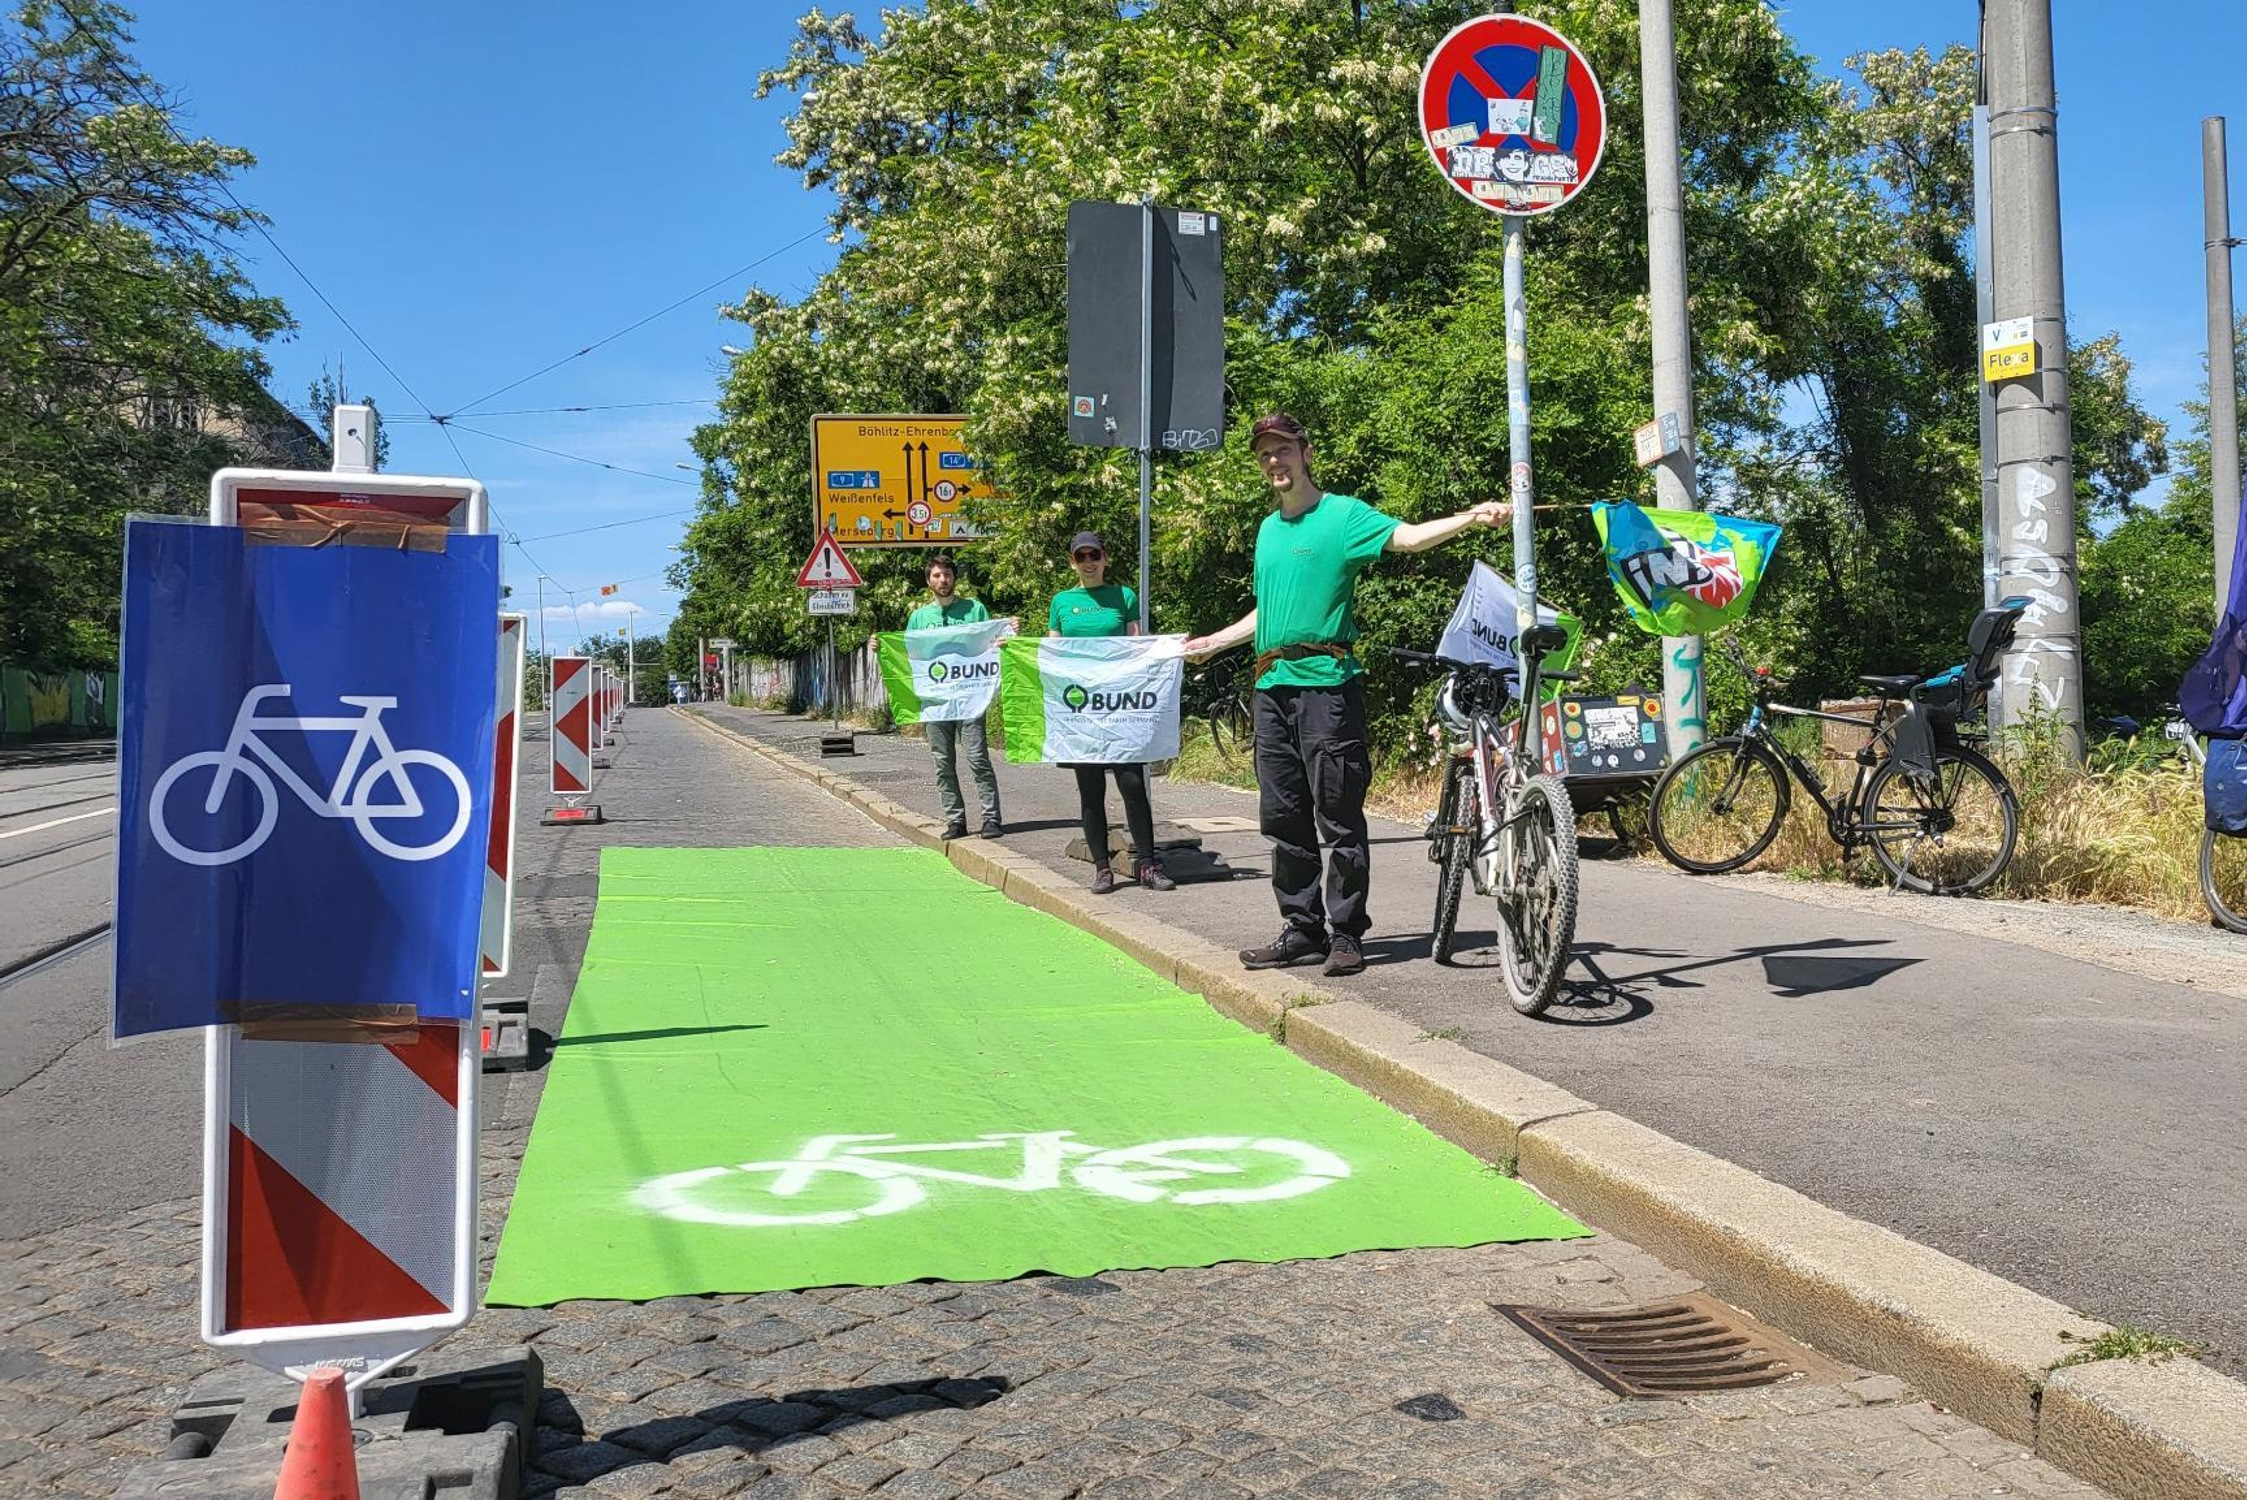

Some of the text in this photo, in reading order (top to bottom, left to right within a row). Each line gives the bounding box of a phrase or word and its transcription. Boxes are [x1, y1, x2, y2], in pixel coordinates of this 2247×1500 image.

[1992, 329, 2001, 342] V
[949, 456, 958, 465] 14
[839, 475, 845, 485] 9
[828, 493, 895, 504] Weißenfels
[950, 662, 999, 679] BUND
[1091, 691, 1157, 711] BUND
